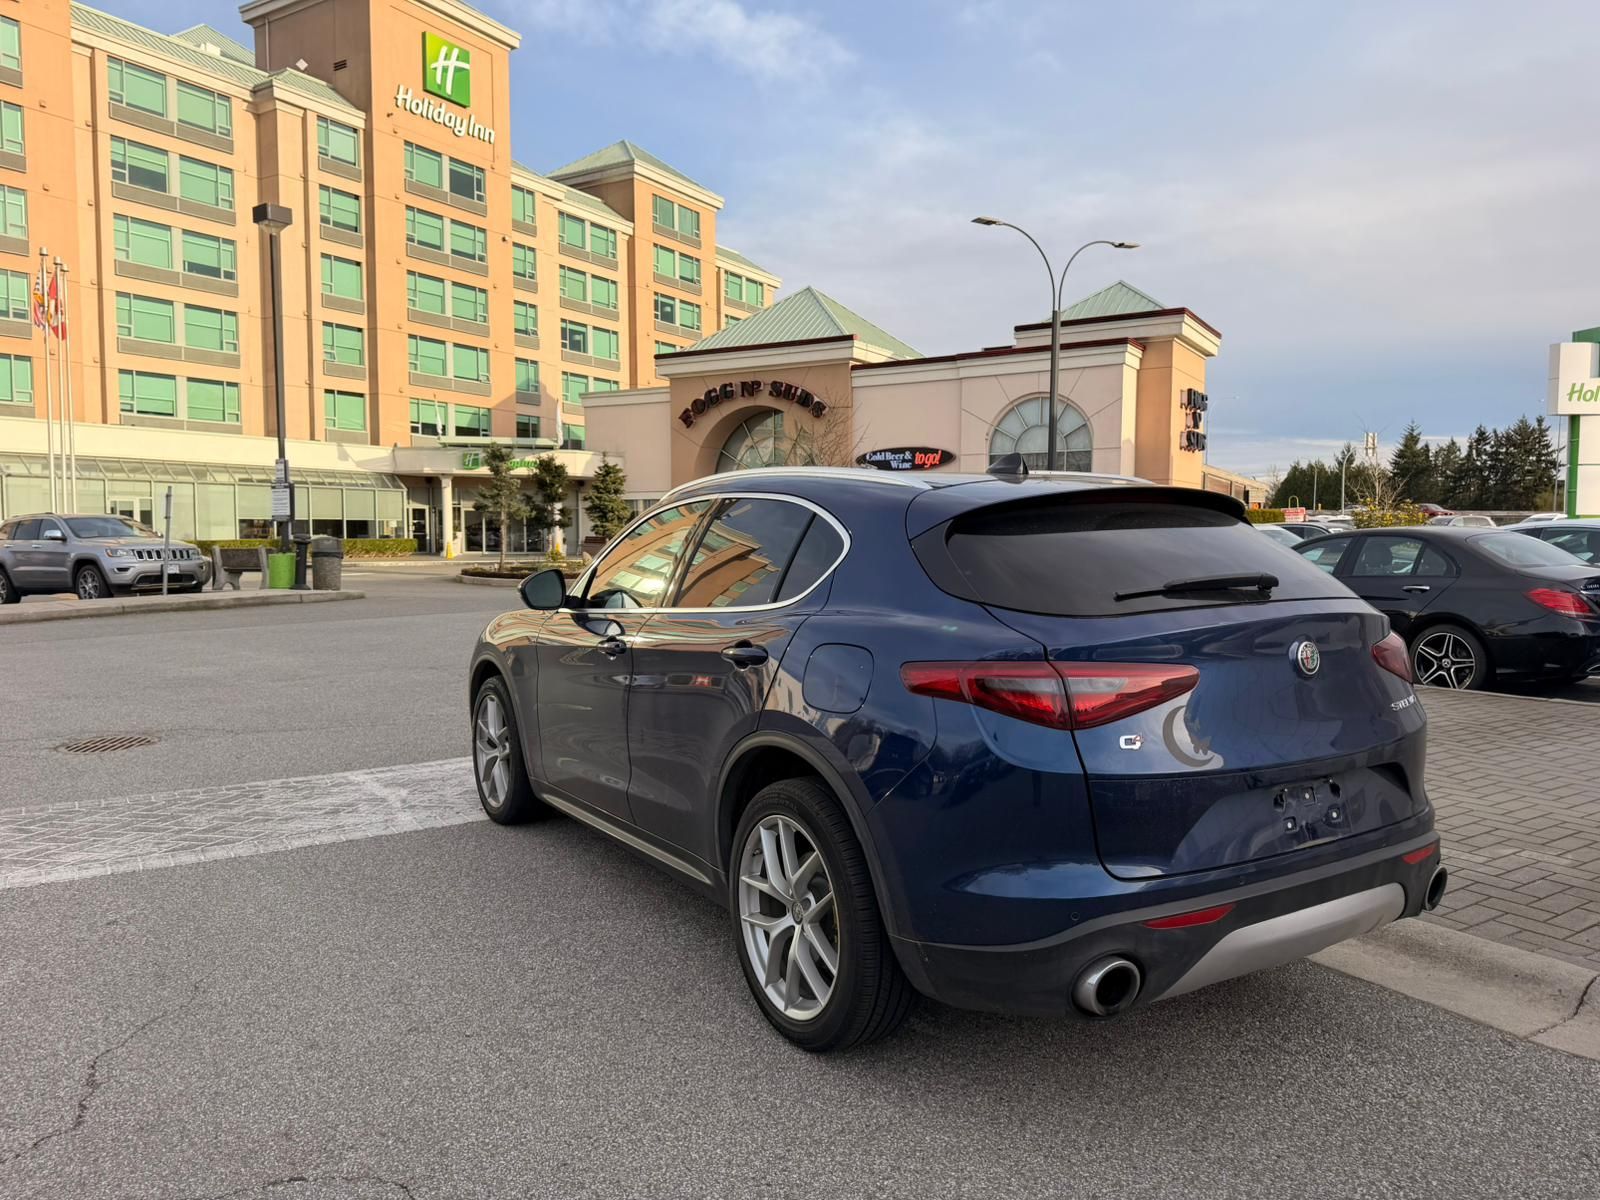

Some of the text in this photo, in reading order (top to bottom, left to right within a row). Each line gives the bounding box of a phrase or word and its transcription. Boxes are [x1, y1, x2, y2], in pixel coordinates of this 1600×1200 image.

[395, 84, 495, 145] Holiday Inn
[678, 381, 735, 429] FOGG
[768, 380, 828, 419] SUDS
[866, 452, 885, 461] Cold
[886, 452, 904, 460] Beer
[890, 461, 912, 469] Wine
[915, 450, 942, 468] to go!
